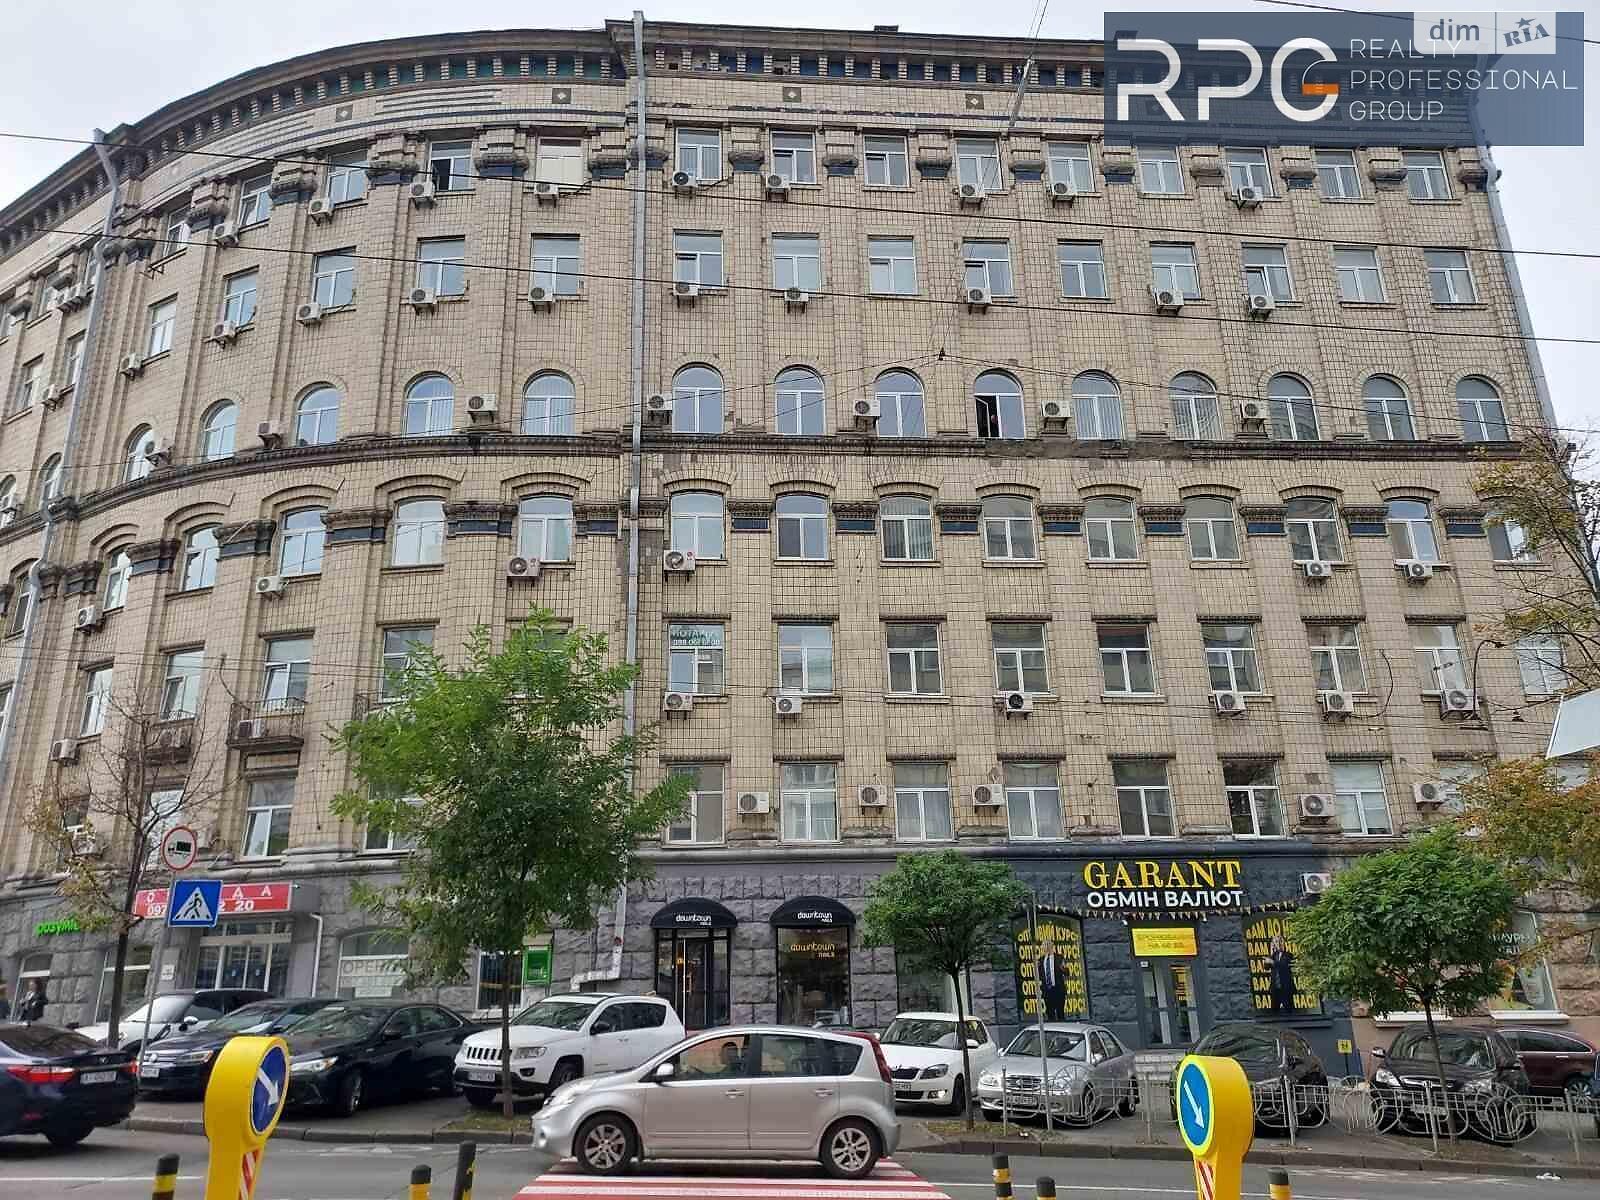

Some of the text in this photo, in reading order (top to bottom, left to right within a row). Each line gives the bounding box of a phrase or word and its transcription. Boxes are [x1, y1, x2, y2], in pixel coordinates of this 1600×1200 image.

[1083, 861, 1241, 889] GARANT
[1087, 890, 1244, 908] ОБМІН ВАЛЮТ
[676, 913, 711, 922] downtown
[798, 911, 832, 919] downtown
[790, 941, 835, 951] downtown
